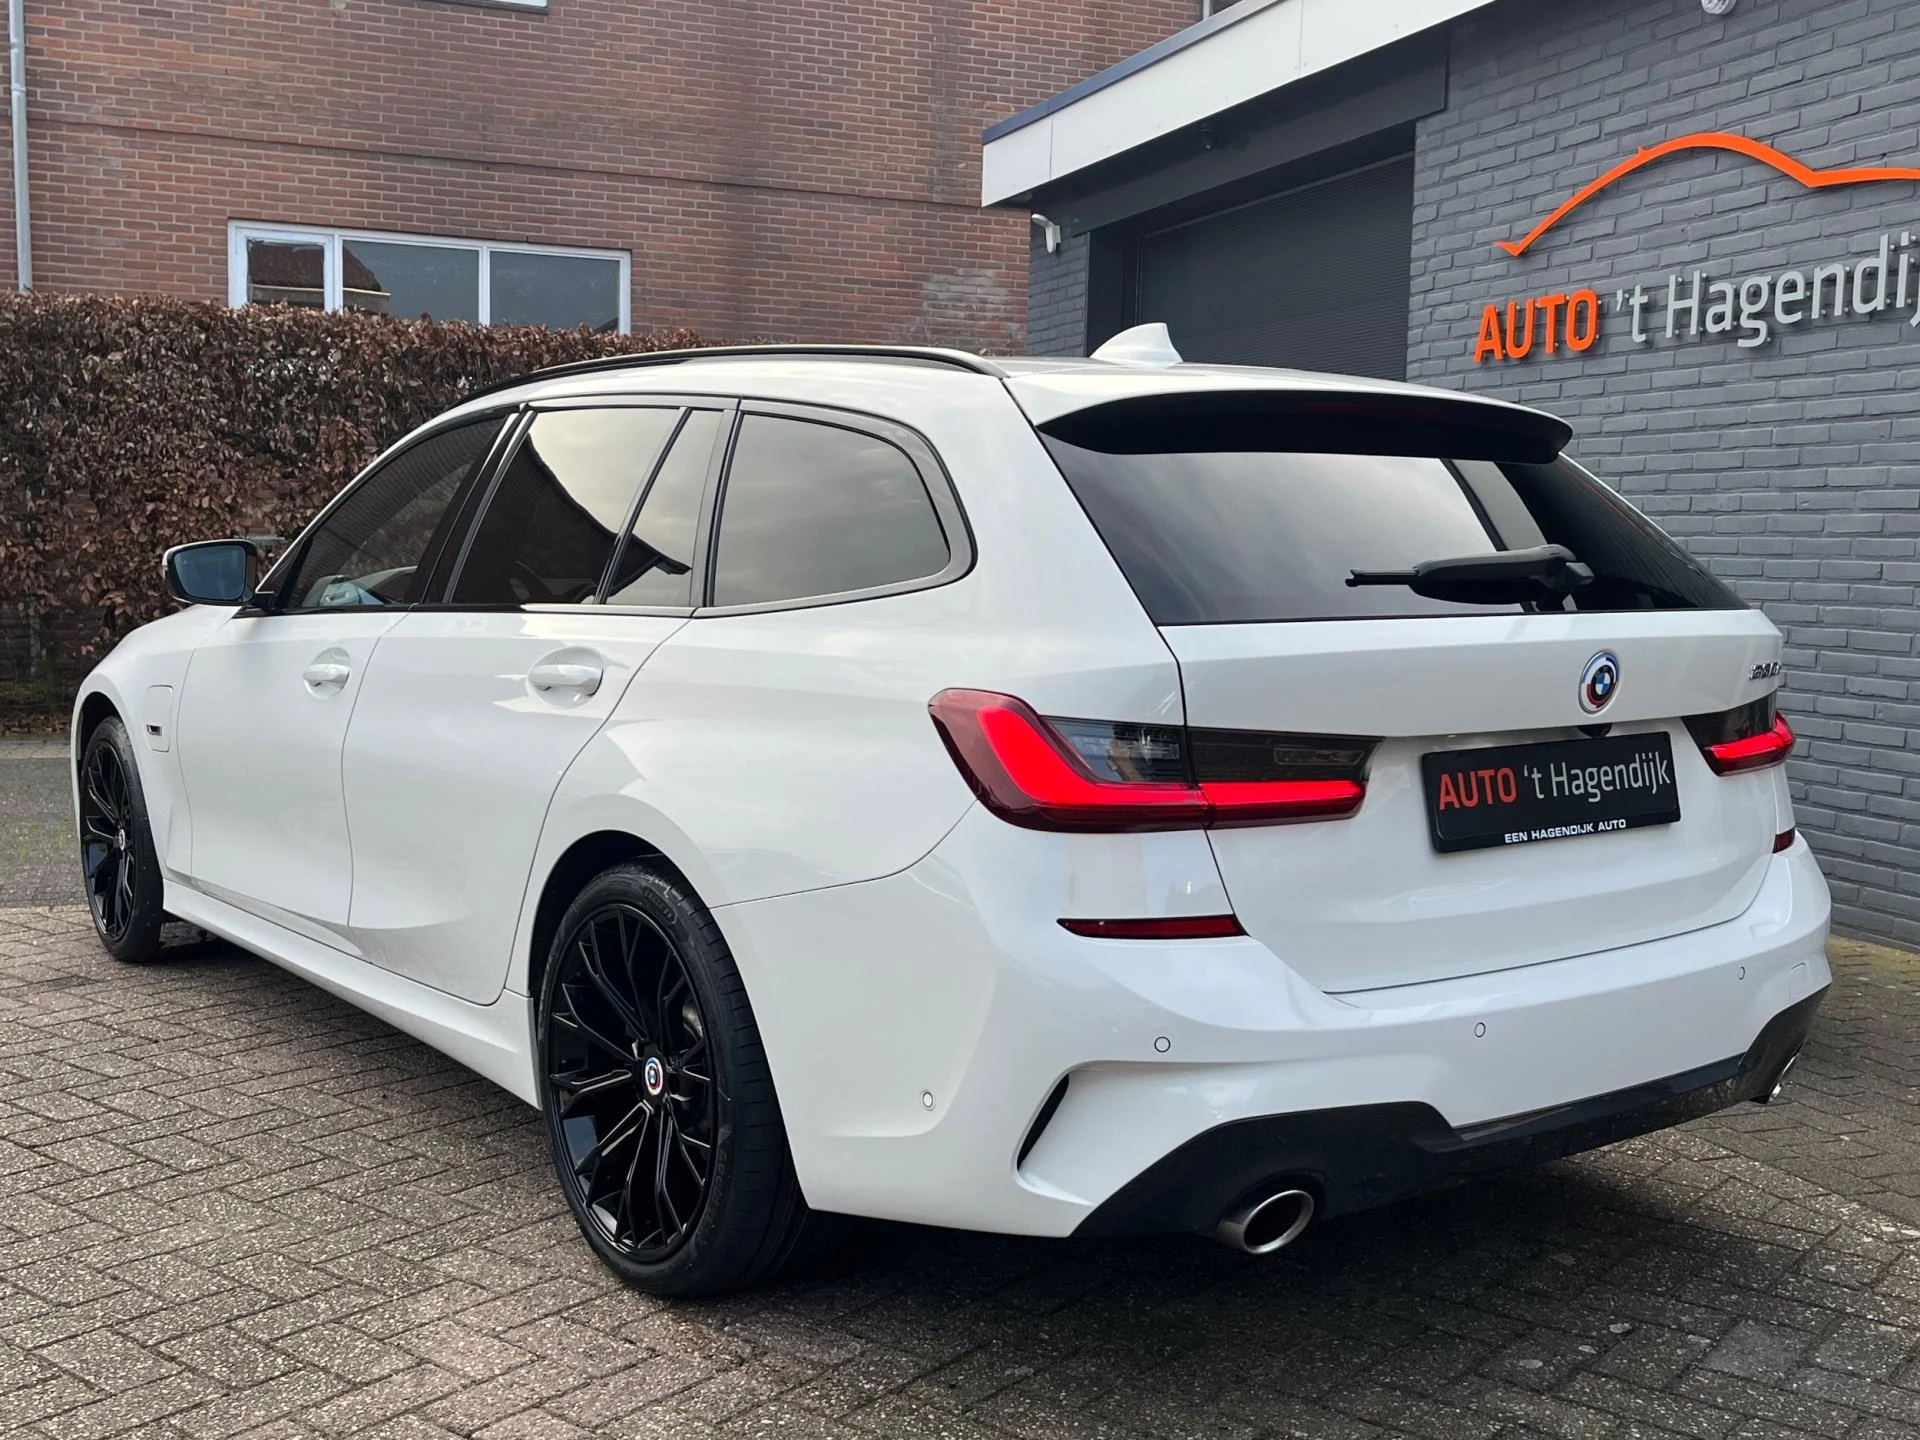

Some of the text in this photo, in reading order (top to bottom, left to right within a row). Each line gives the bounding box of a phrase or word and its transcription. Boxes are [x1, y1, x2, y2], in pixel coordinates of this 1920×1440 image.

[1473, 289, 1598, 364] AUTO
[1665, 231, 1920, 348] Hagendi
[1439, 767, 1517, 810] AUTO
[1550, 751, 1671, 803] Hagendijk
[1504, 818, 1627, 844] EEN HAGENDIJK AUTO
